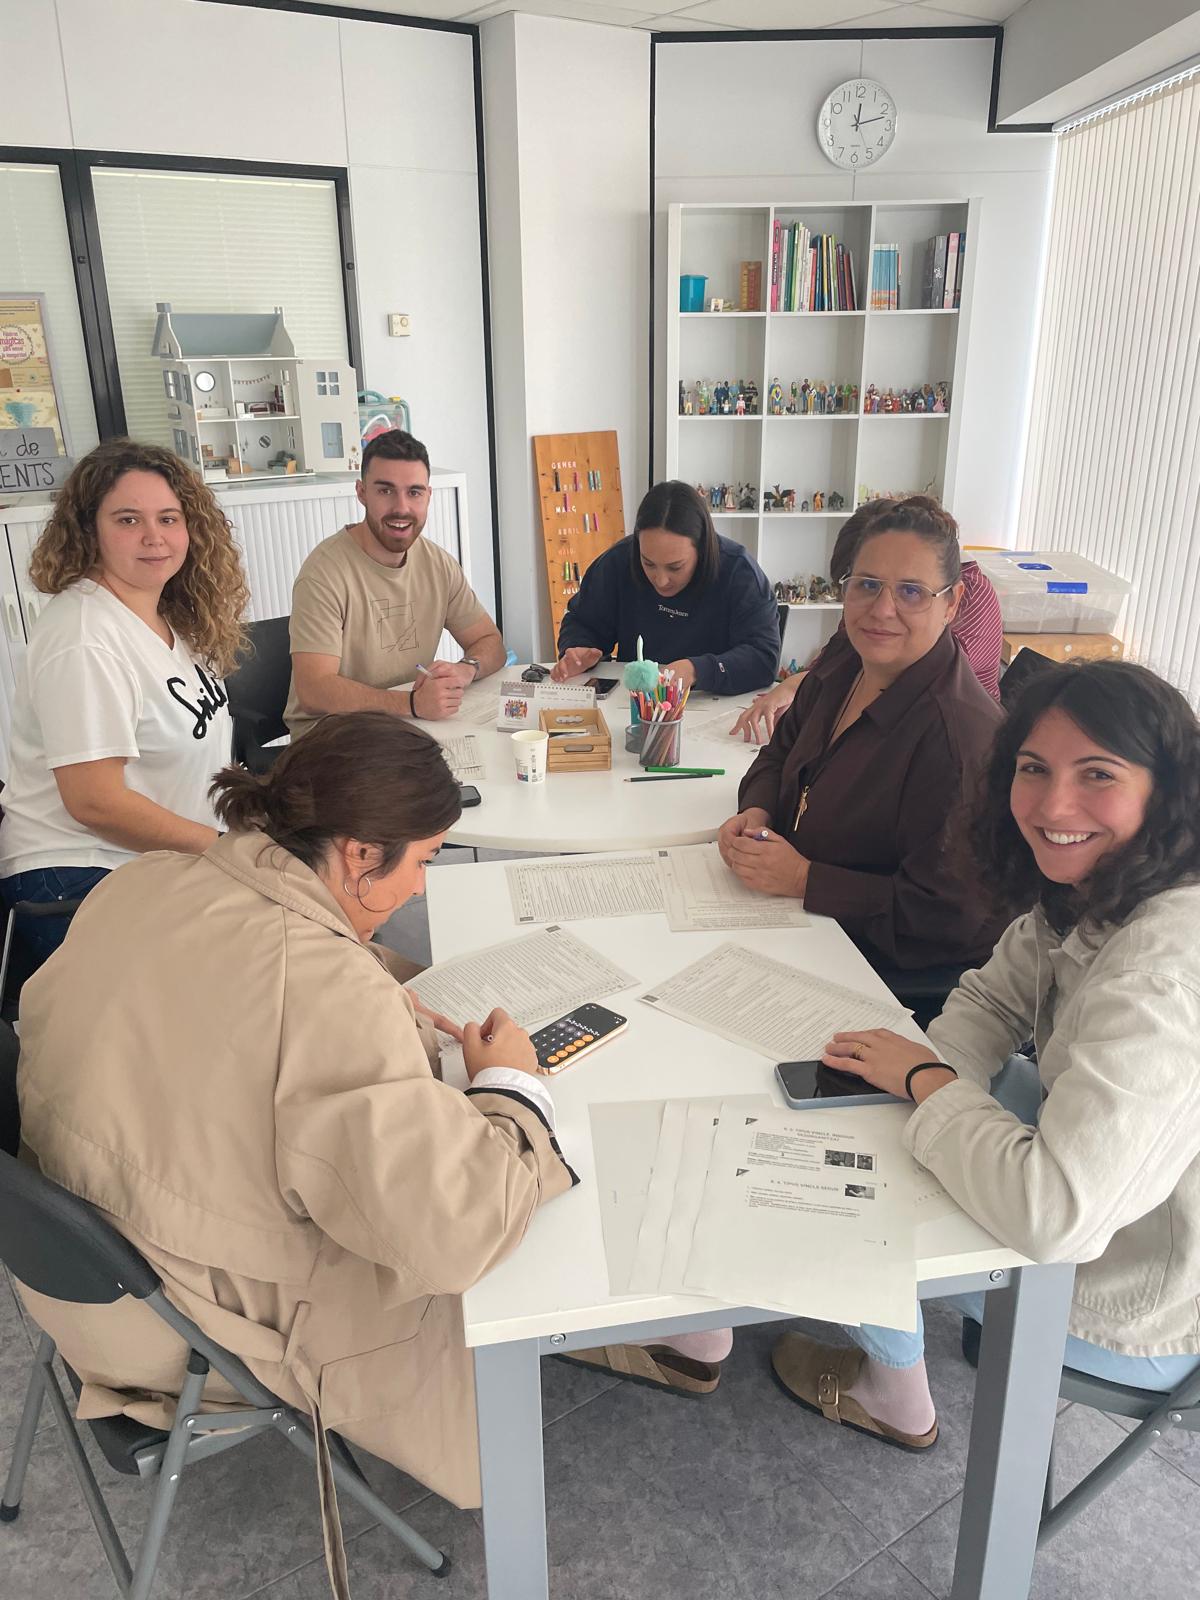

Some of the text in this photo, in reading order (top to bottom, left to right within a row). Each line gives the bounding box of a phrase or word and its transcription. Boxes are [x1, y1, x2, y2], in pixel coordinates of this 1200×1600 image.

[843, 90, 851, 102] 11
[856, 85, 866, 98] 12
[873, 90, 877, 103] 1
[830, 102, 842, 114] 10
[880, 102, 889, 115] 2
[884, 119, 892, 132] 3
[876, 135, 884, 147] 4
[838, 146, 845, 158] 7
[850, 151, 858, 164] 6
[865, 147, 873, 160] 5
[16, 434, 39, 457] de
[0, 462, 54, 488] ENTS
